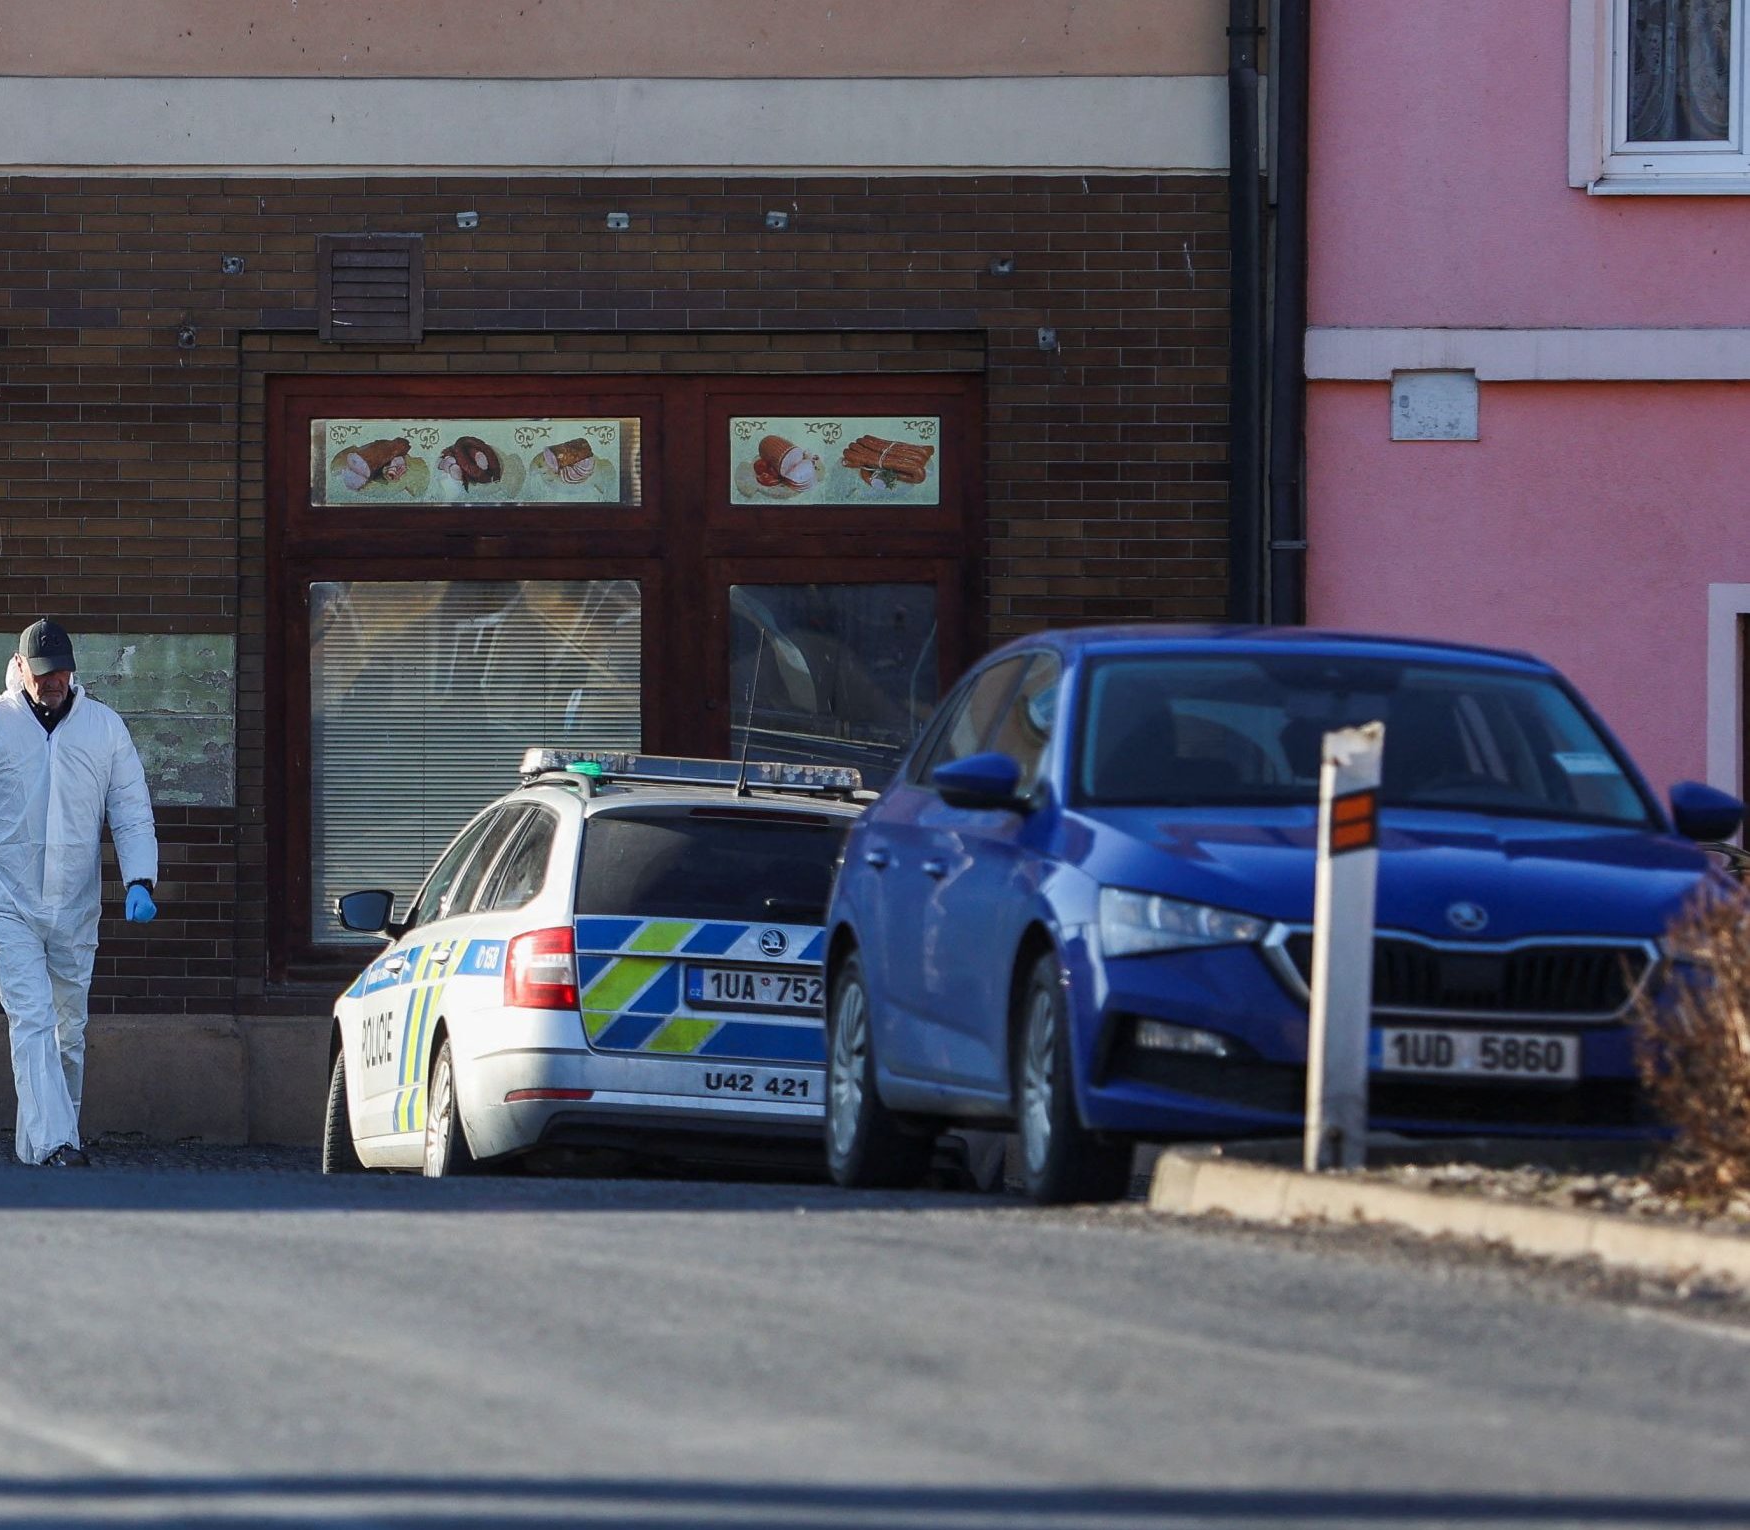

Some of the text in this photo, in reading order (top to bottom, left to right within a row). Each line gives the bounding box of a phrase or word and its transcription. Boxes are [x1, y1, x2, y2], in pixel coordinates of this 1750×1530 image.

[689, 988, 702, 998] CZ
[711, 972, 756, 1000] 1UA
[362, 1011, 394, 1069] POLICIE
[1393, 1033, 1565, 1073] 1UD 5860
[705, 1072, 810, 1098] U42 421
